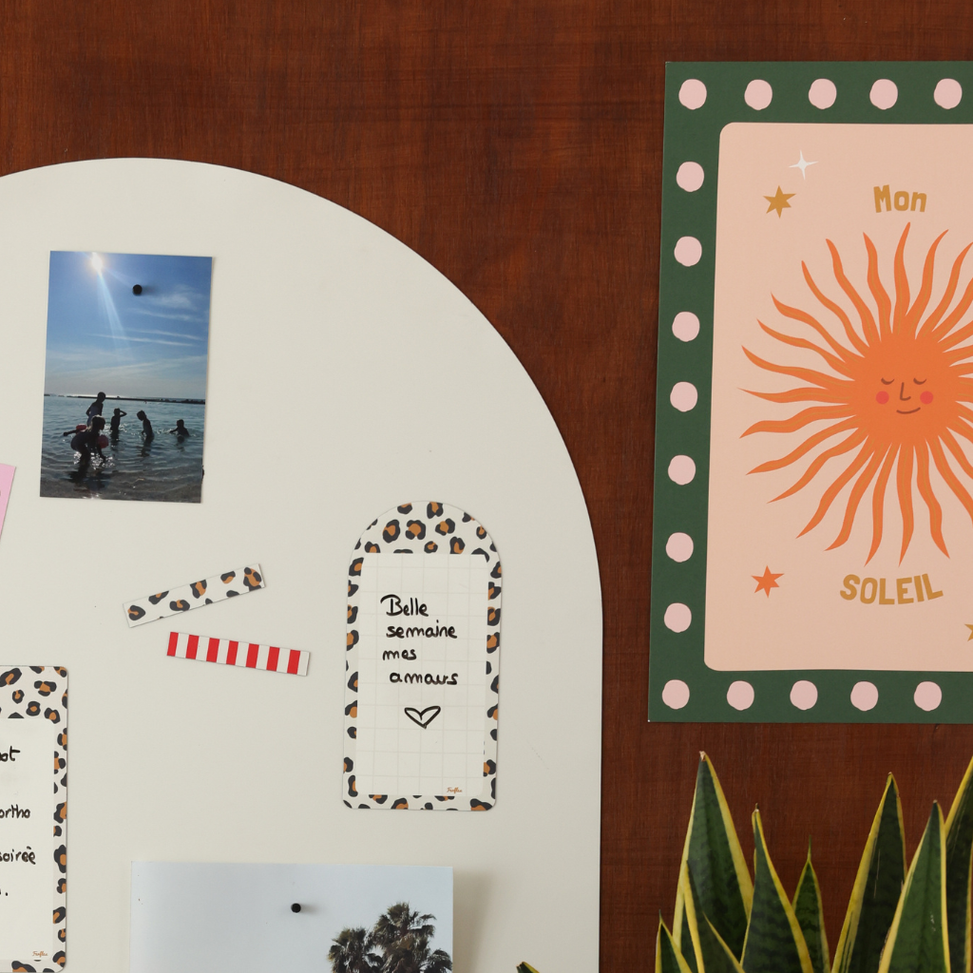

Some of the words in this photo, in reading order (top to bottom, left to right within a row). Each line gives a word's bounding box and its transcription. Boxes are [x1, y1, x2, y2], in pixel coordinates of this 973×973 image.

[873, 184, 927, 214] Mon
[839, 573, 944, 606] SOLEIL
[380, 593, 429, 617] Belle
[386, 619, 458, 639] semaine
[382, 648, 418, 661] mes
